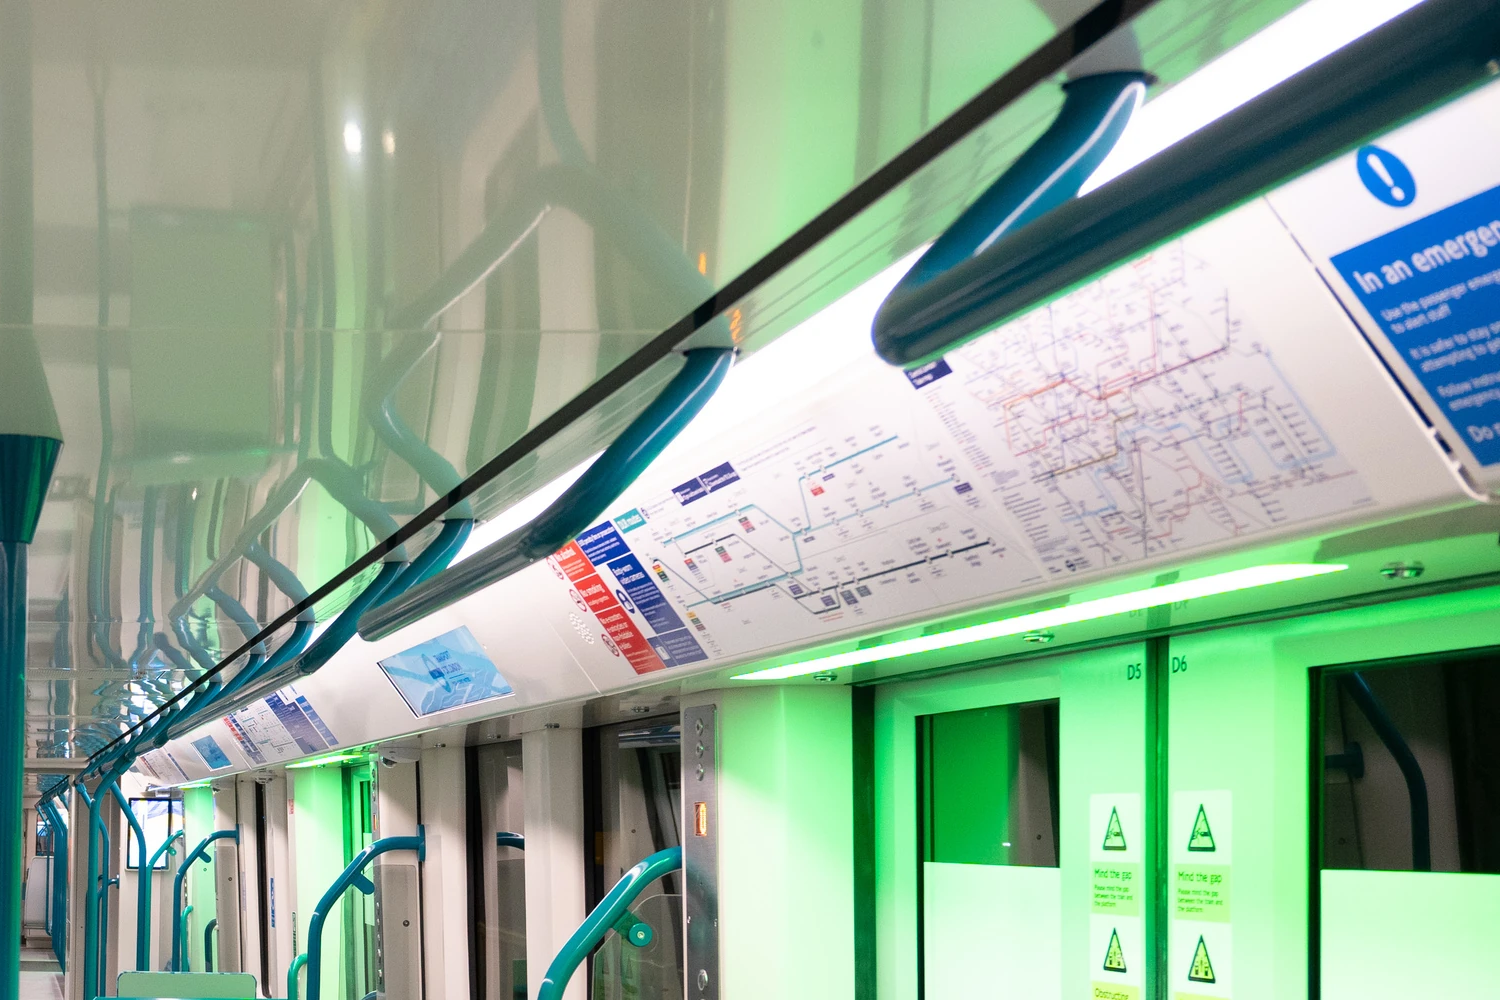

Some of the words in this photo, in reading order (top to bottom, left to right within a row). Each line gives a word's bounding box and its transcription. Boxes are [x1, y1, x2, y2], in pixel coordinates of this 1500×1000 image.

[1353, 271, 1384, 294] In
[1381, 260, 1413, 284] an
[1467, 425, 1494, 443] Do
[1128, 663, 1141, 680] D5
[1172, 655, 1187, 673] D6
[1095, 869, 1108, 879] Mind
[1109, 869, 1120, 879] the
[1122, 871, 1132, 881] gap
[1178, 871, 1194, 881] Mind
[1196, 872, 1208, 882] the
[1210, 874, 1222, 885] gap
